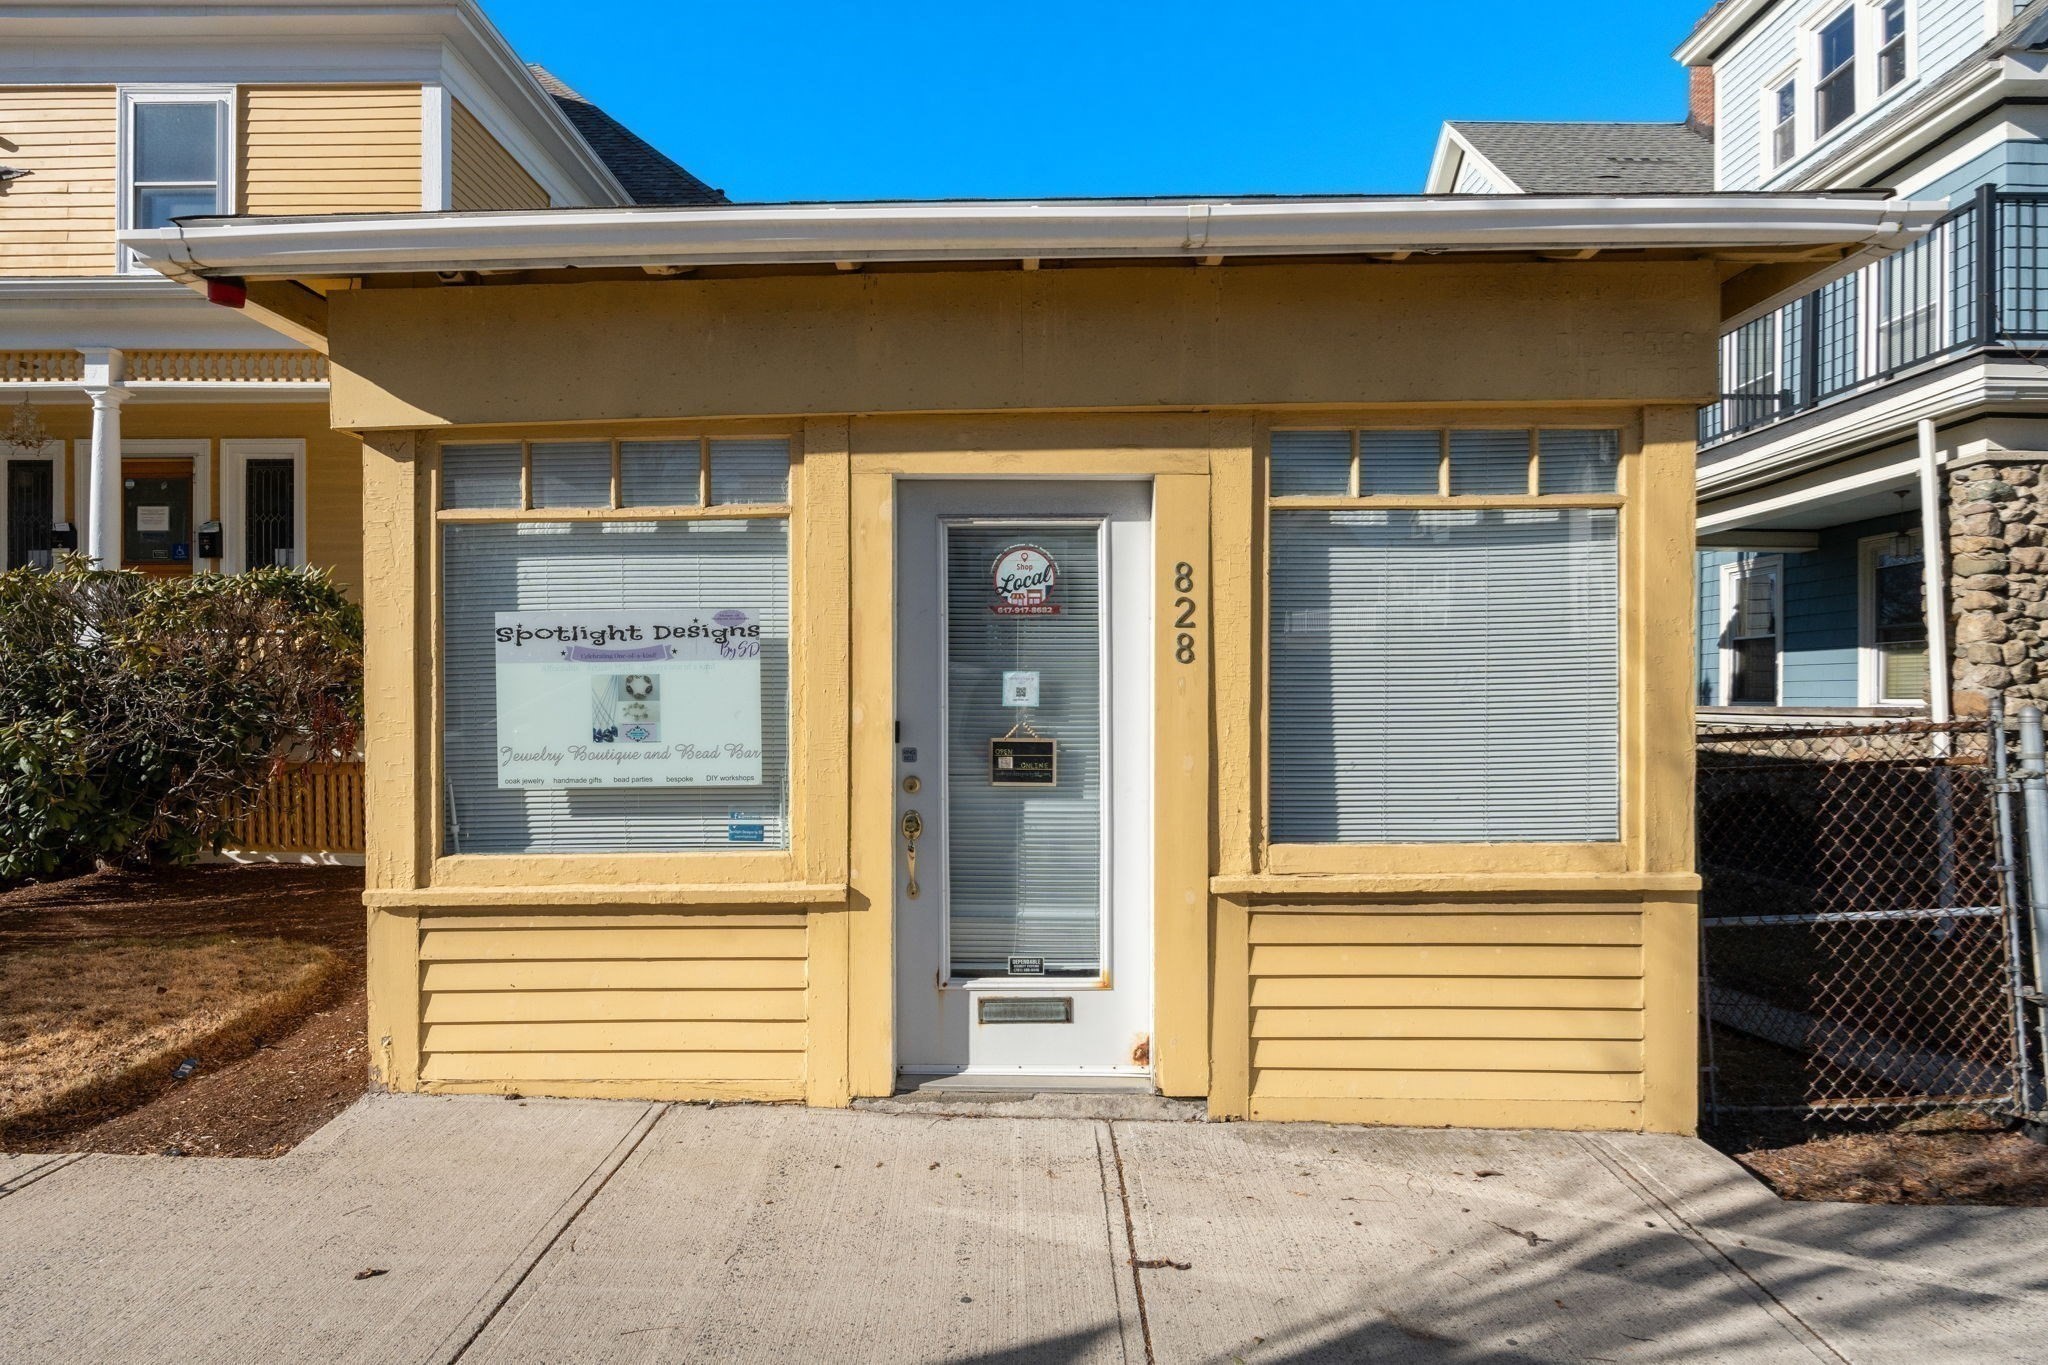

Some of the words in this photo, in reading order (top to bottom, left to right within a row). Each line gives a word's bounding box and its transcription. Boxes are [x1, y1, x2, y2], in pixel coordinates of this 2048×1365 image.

[1016, 563, 1033, 572] Shop
[995, 564, 1052, 596] Local
[1174, 561, 1197, 664] 828
[496, 623, 643, 646] Spotlight
[653, 623, 760, 644] Designs
[500, 745, 565, 767] Jewelry
[567, 744, 641, 766] Boutique
[643, 744, 672, 760] and
[674, 743, 720, 760] Bead
[723, 743, 762, 760] Bar
[1020, 761, 1049, 770] ONLINE
[521, 776, 545, 786] jewelry
[553, 776, 588, 784] handmade
[588, 776, 603, 785] gifts
[613, 775, 630, 783] bead
[631, 775, 653, 784] parties
[665, 775, 694, 783] bespoke
[705, 774, 719, 782] DIY
[719, 774, 755, 782] workshops
